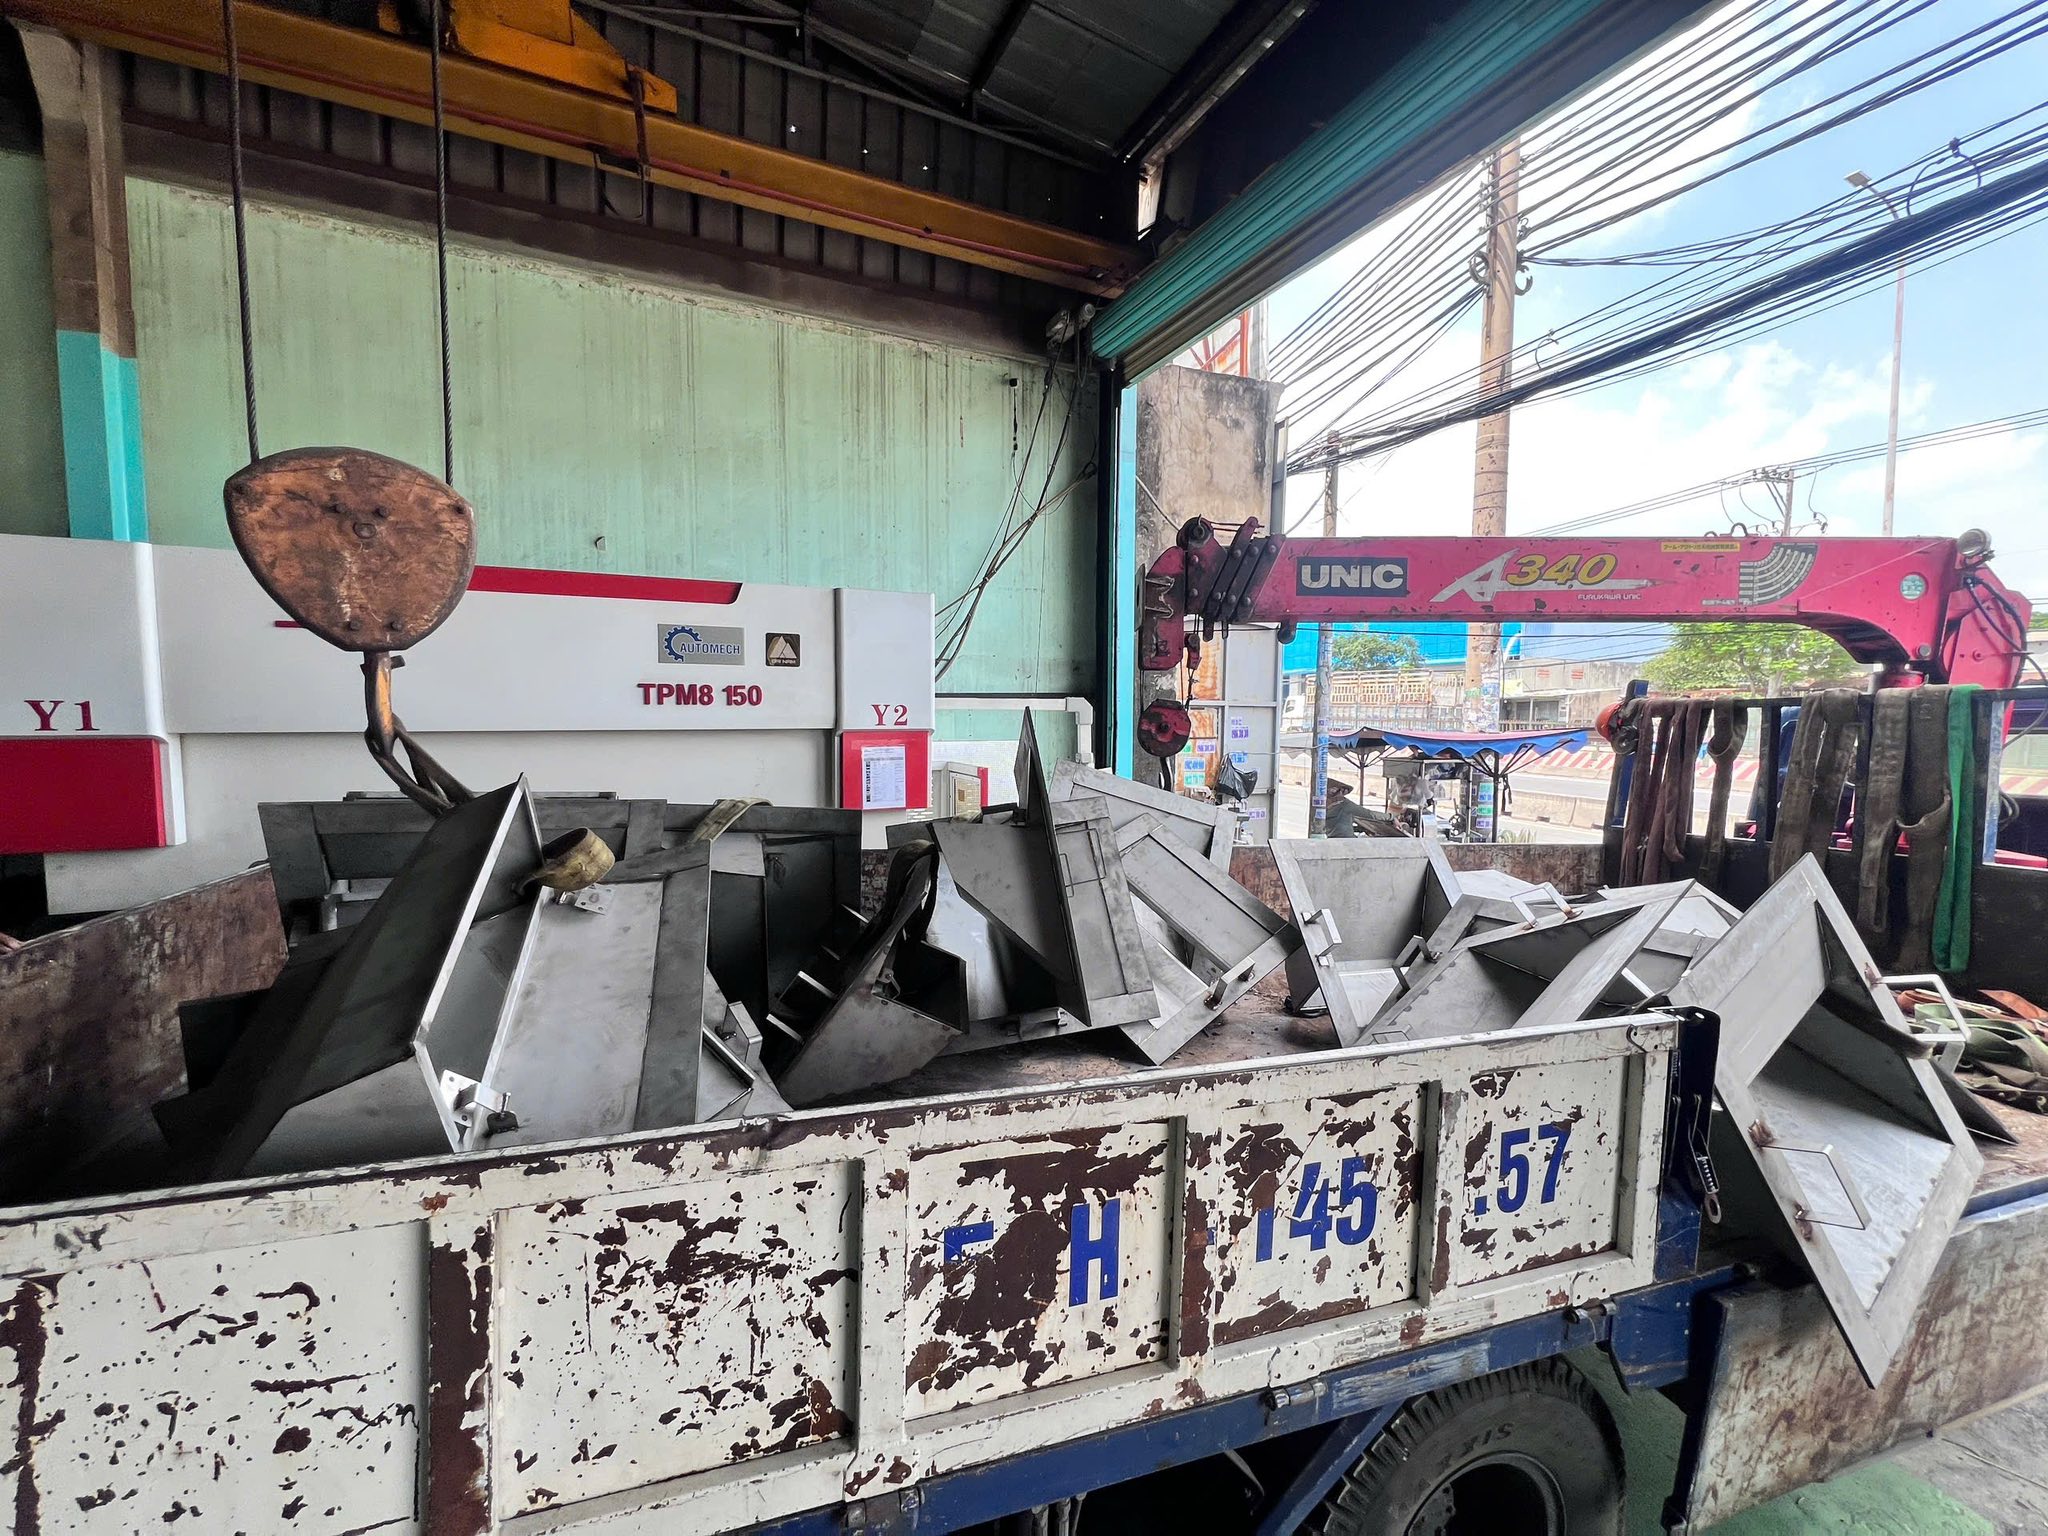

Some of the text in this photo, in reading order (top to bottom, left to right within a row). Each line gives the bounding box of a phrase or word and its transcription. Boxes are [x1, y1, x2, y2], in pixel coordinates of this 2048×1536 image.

[1301, 564, 1404, 590] UNIC
[680, 641, 741, 655] AUTOMECH
[638, 682, 763, 706] TPM8 150
[24, 700, 101, 731] Y1
[871, 704, 909, 726] Y2
